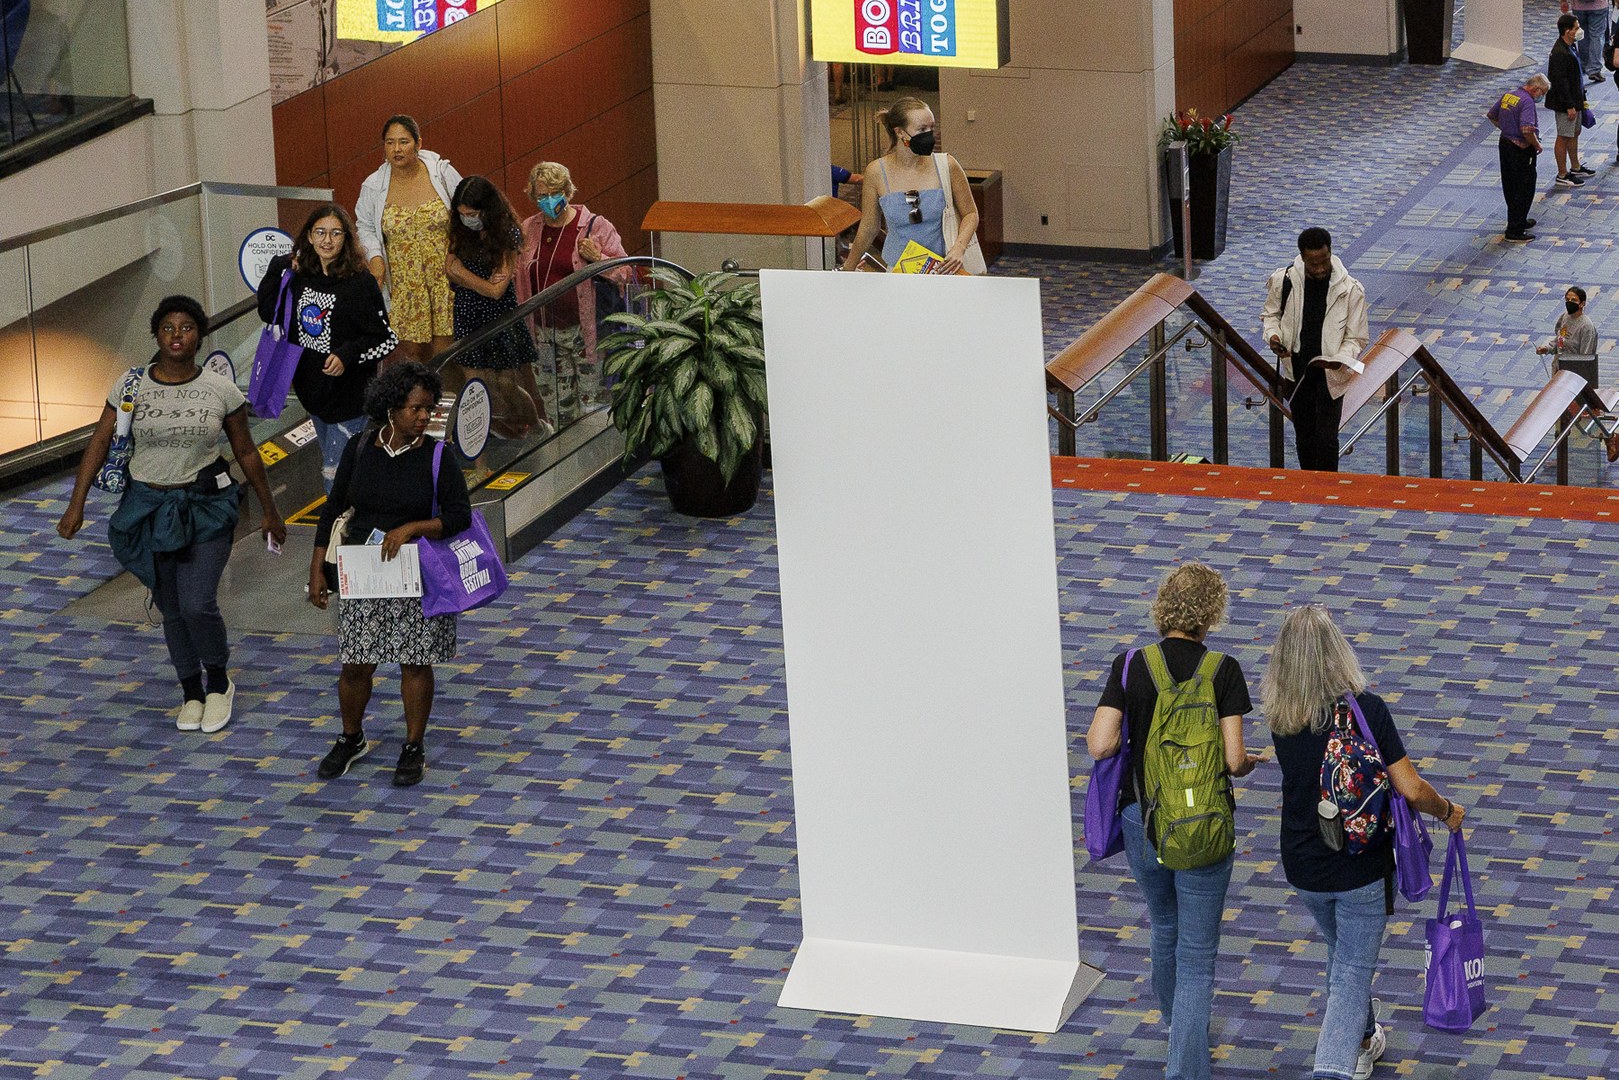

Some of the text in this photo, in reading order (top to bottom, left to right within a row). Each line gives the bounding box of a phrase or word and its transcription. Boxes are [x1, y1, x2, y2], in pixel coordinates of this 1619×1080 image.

[302, 314, 322, 326] NASA
[175, 390, 212, 401] NOT
[168, 426, 209, 436] THE
